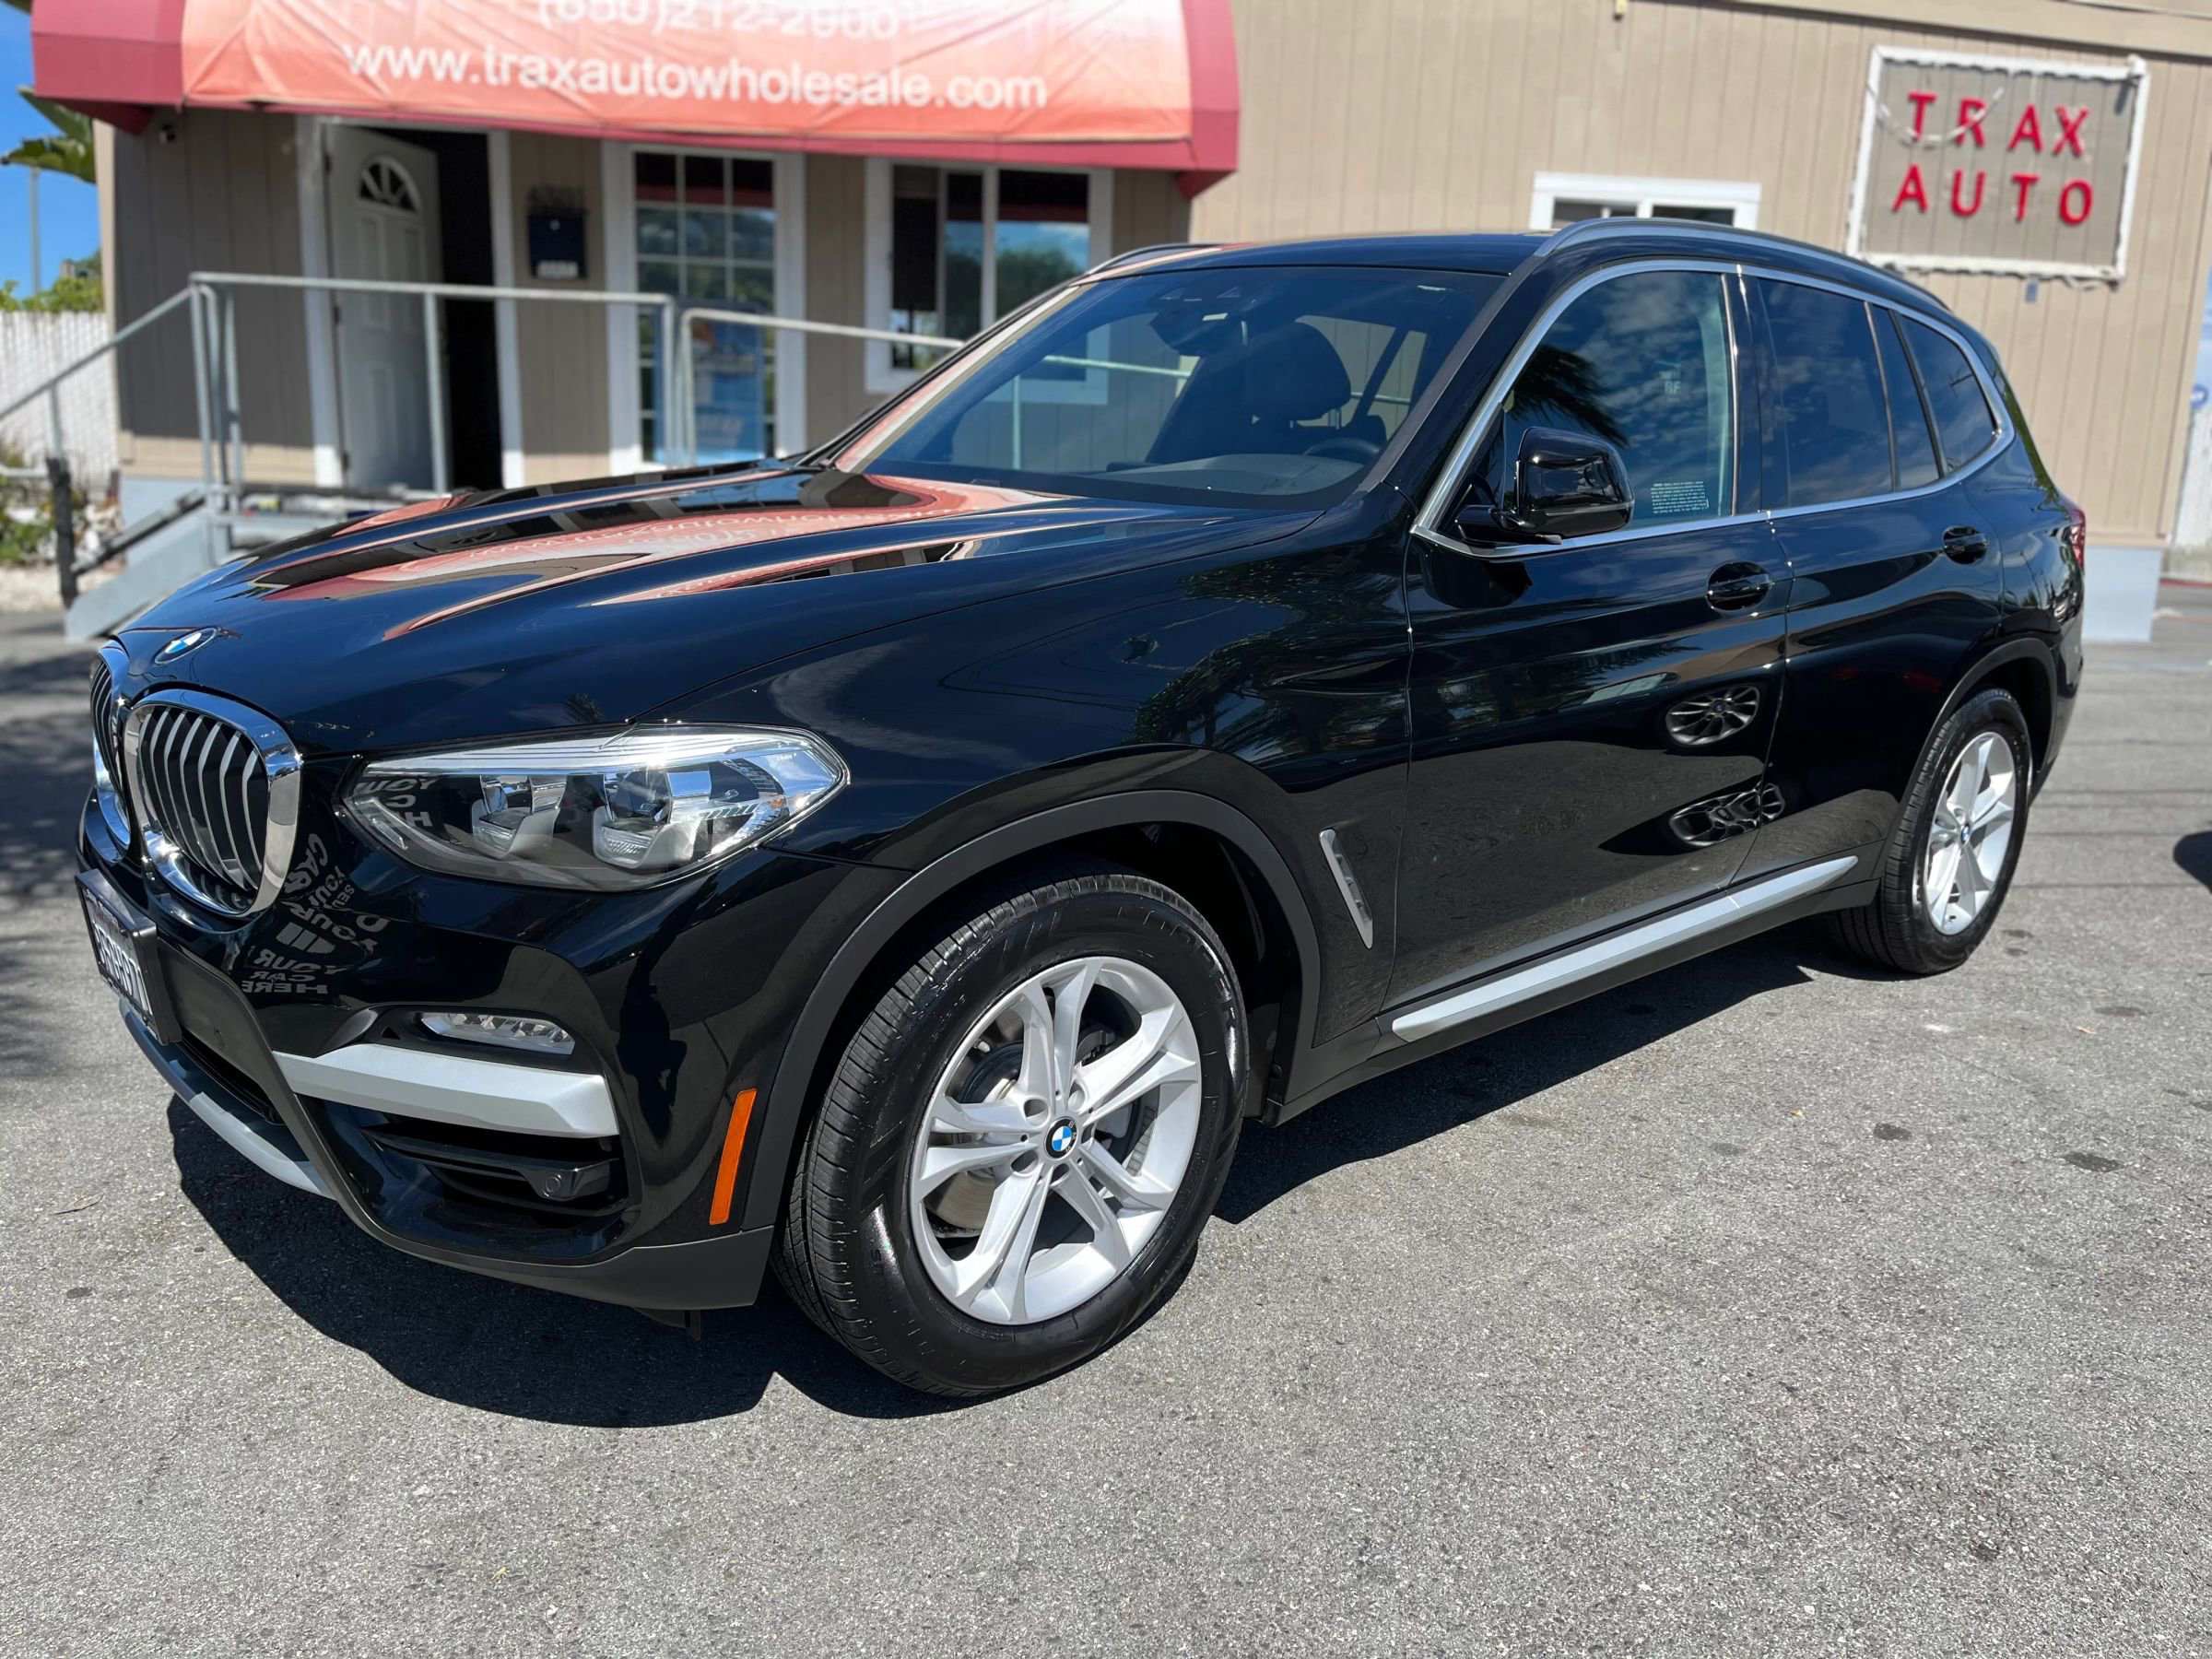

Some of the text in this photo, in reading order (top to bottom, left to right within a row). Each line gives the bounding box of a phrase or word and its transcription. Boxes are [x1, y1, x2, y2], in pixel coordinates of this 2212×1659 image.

[339, 42, 1047, 110] www.traxautowholesale.com
[1907, 91, 2089, 159] TRAX
[1891, 163, 2094, 225] AUTO
